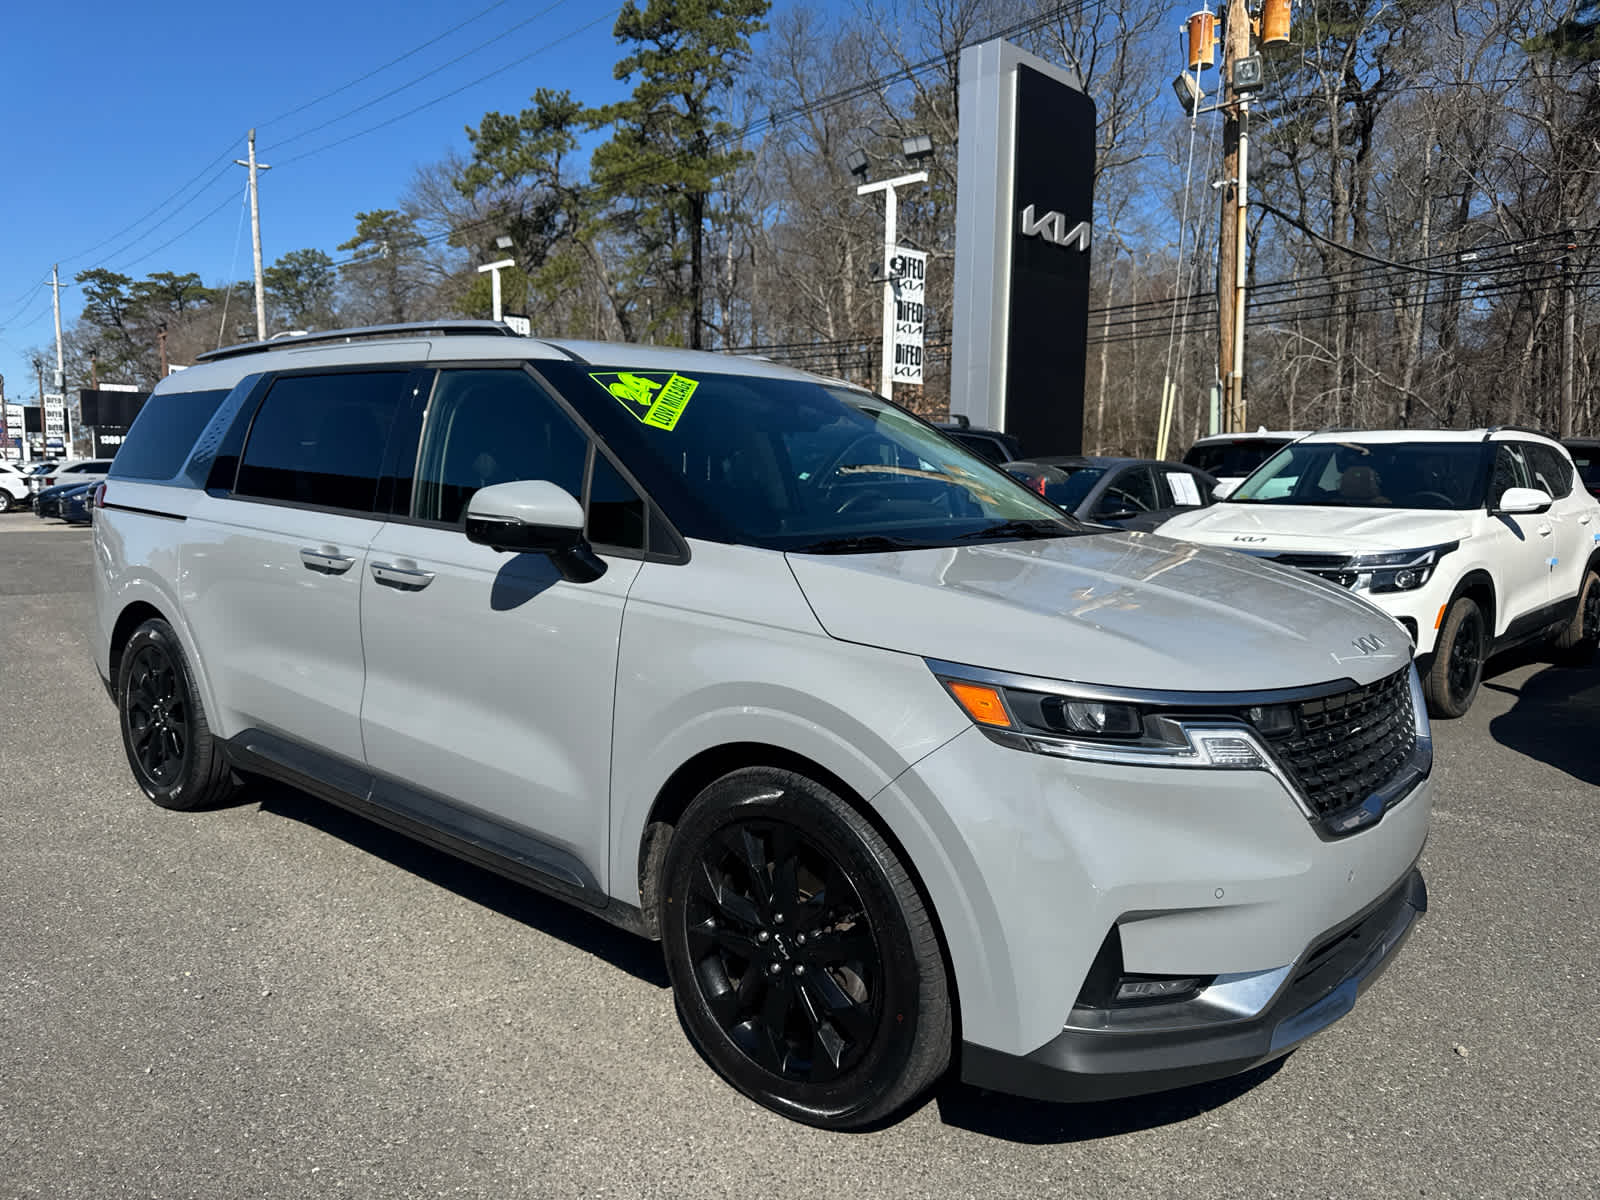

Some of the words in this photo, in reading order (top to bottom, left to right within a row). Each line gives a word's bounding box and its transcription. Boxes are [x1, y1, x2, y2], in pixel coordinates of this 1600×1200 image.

[1022, 204, 1090, 251] KIA
[896, 323, 922, 334] KIA
[894, 366, 921, 377] KIA
[609, 371, 662, 406] 24
[660, 378, 692, 410] MILEAGE
[650, 404, 676, 427] LOW
